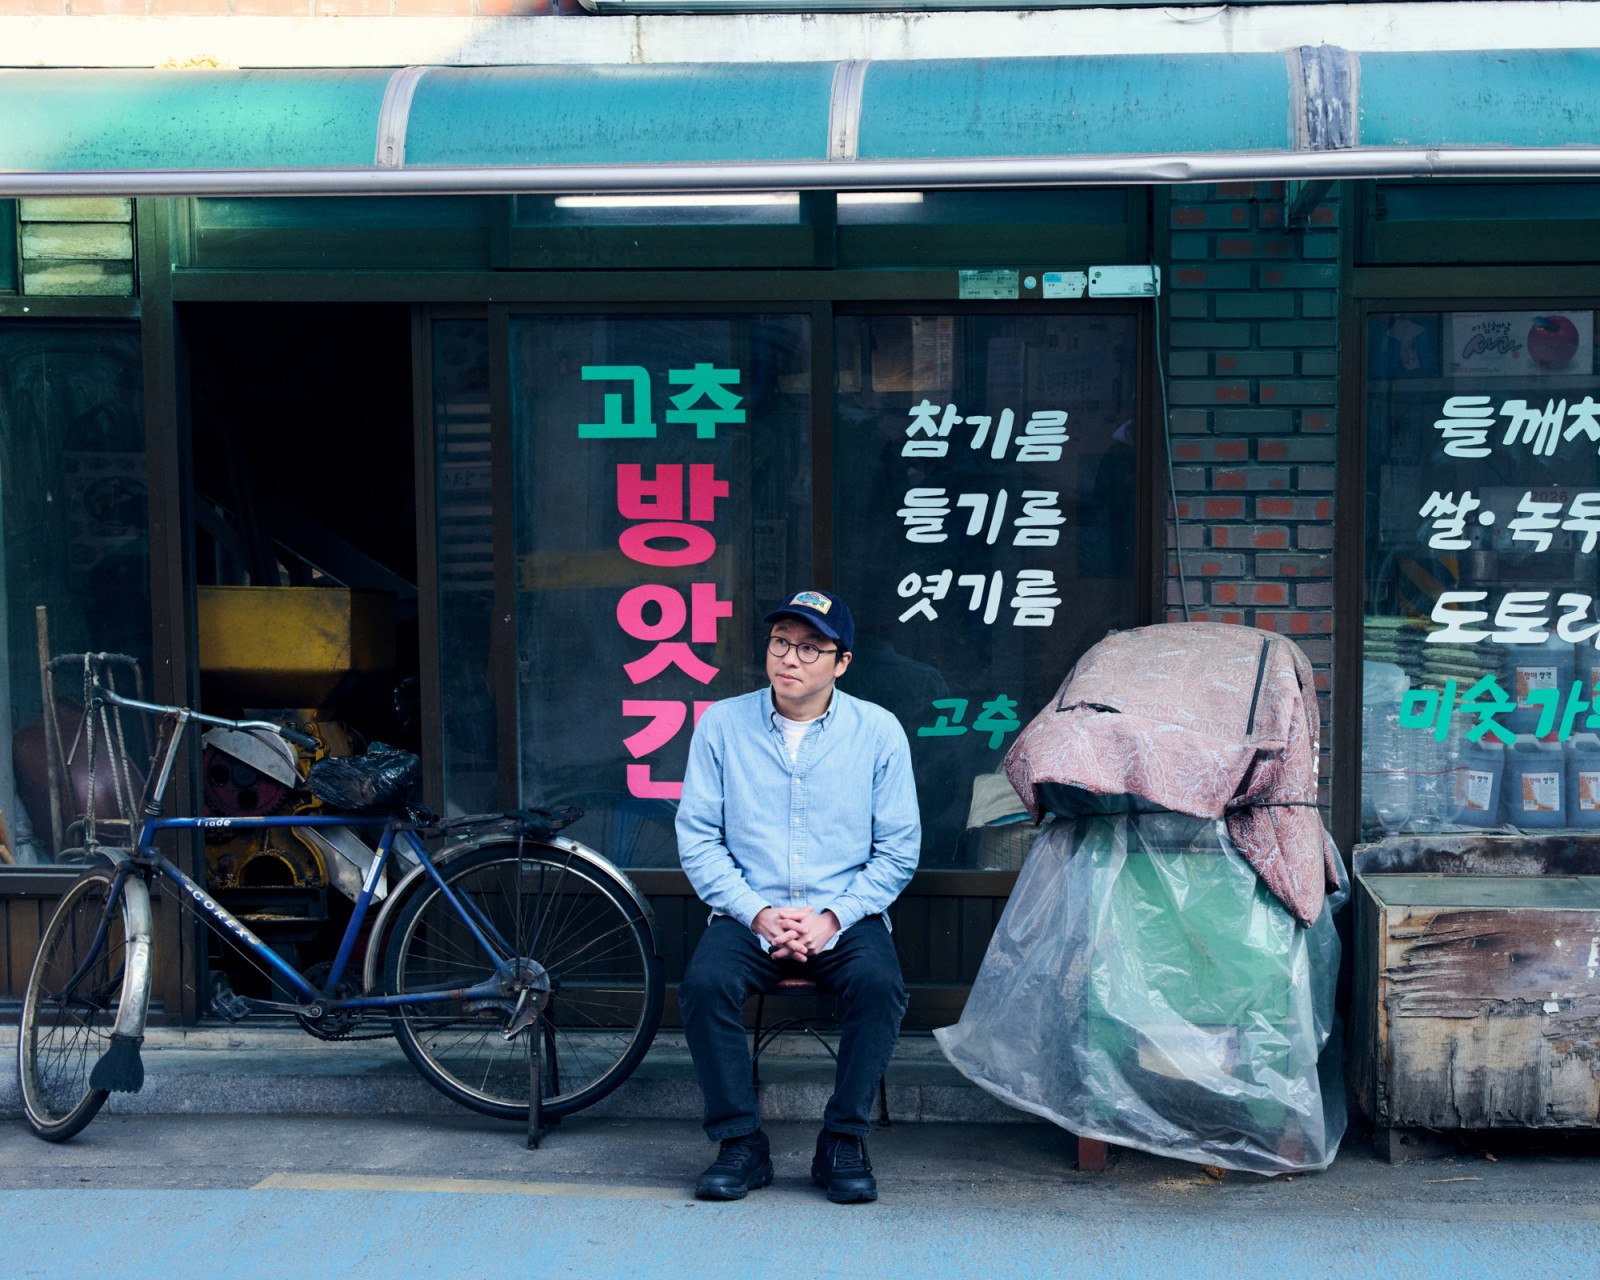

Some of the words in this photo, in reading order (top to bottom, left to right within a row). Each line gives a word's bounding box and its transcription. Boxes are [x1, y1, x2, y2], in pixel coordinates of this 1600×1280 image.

[578, 363, 746, 439] 고추
[902, 399, 1069, 462] 참기름
[1530, 490, 1569, 503] 2026
[897, 568, 1062, 627] 엿기름
[917, 694, 1021, 750] 고추
[1399, 673, 1600, 747] 미숫가
[192, 890, 249, 938] COREX
